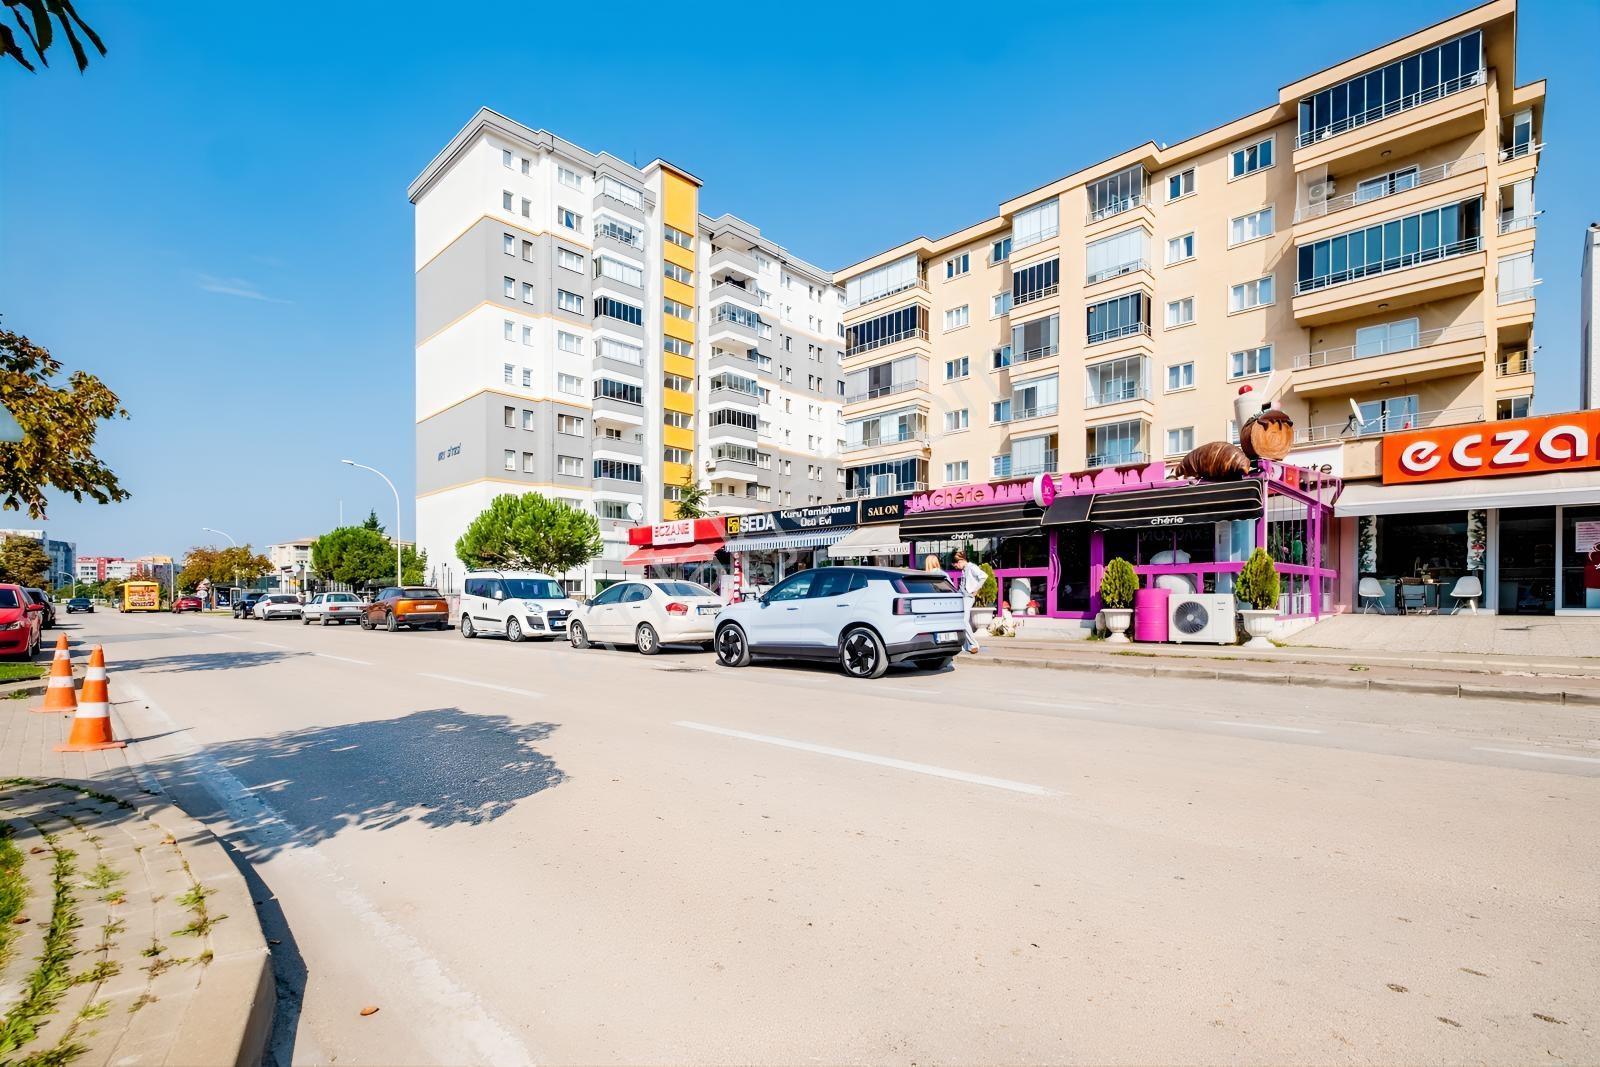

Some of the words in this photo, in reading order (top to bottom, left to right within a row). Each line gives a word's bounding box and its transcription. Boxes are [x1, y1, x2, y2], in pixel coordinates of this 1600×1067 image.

[1399, 425, 1600, 474] ecza
[934, 487, 984, 506] chérie
[867, 504, 899, 517] SALON
[654, 522, 690, 538] ECZANE
[740, 513, 776, 532] SEDA
